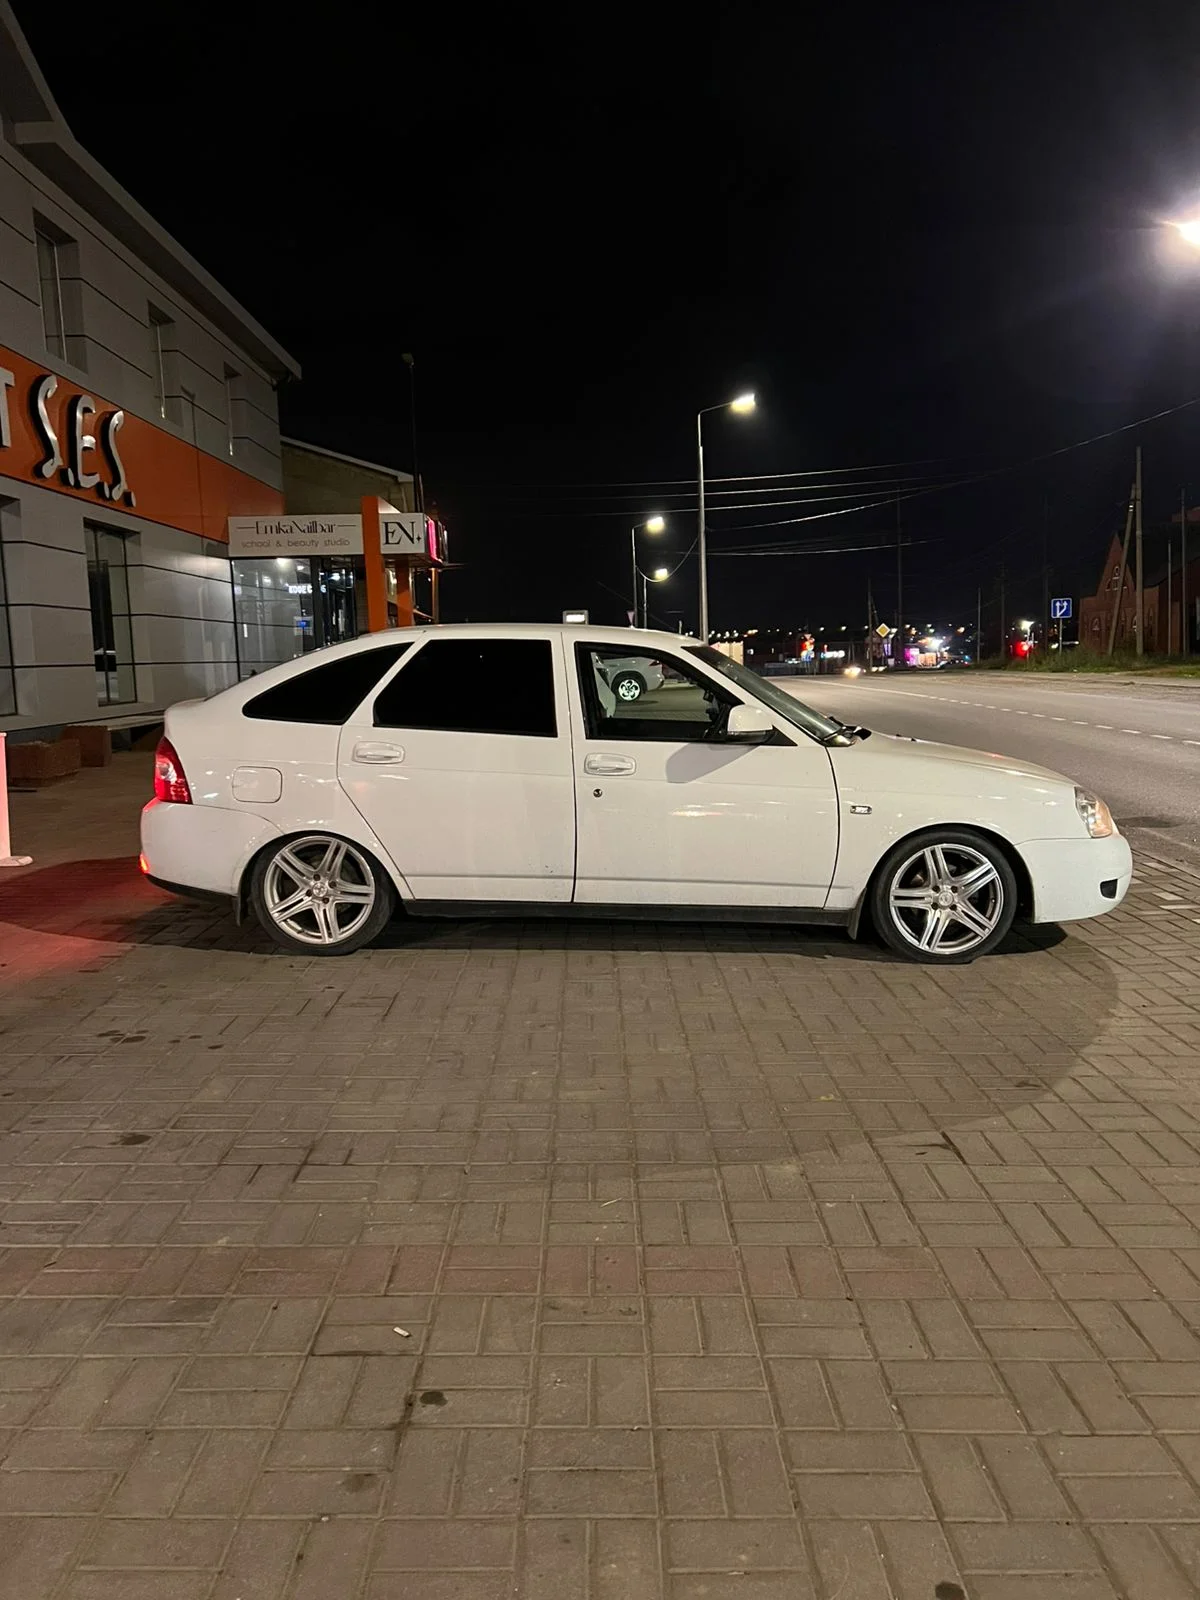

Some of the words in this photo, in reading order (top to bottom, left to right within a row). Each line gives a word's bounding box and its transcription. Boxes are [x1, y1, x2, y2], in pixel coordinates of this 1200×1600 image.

[241, 538, 271, 549] school
[275, 539, 282, 547] &
[287, 538, 320, 549] beauty
[323, 537, 350, 547] studio
